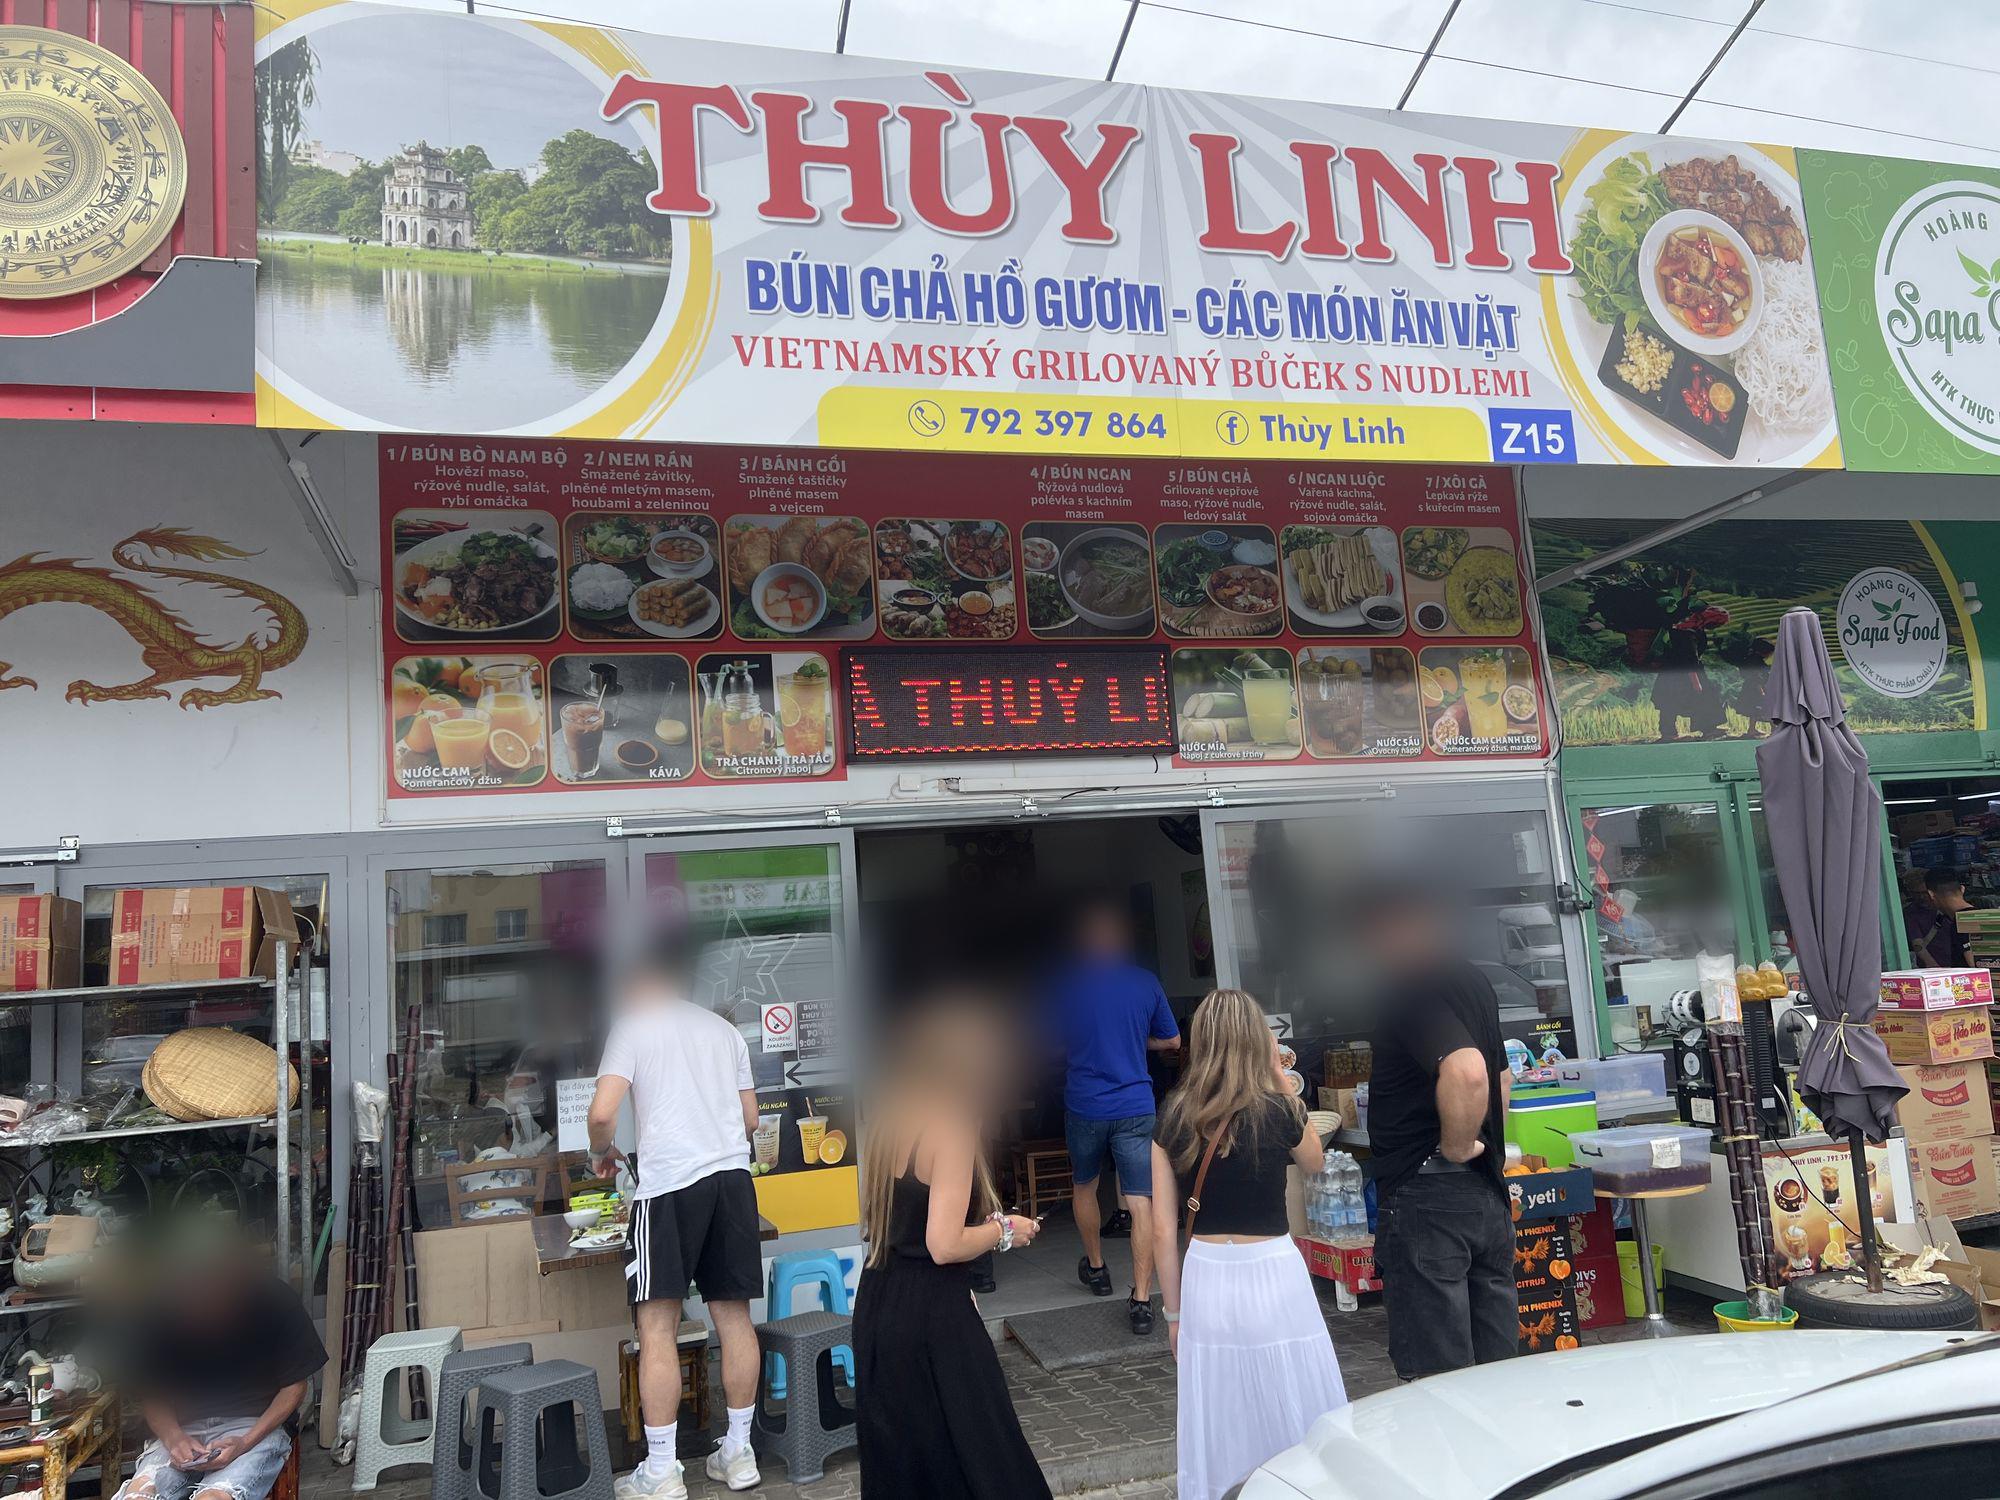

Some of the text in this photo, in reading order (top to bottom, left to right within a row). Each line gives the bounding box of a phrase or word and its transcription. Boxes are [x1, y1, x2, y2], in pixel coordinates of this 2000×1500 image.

[602, 70, 1574, 272] THÙY LINH
[1923, 209, 1988, 242] HOÀNG
[745, 252, 1520, 359] BÚN CHẢ HỒ GƯƠM - CÁC MÓN ĂN VẶT
[1886, 280, 1985, 356] Sapa
[732, 335, 1532, 398] VIETNAMSKÝ GRILOVANÝ BŮČEK S NUDLEMI
[1930, 369, 1995, 425] HTK THỰC
[960, 407, 1167, 440] 792 397 864
[1259, 414, 1405, 450] Thùy Linh
[1500, 423, 1565, 455] Z15
[387, 448, 395, 461] 1
[411, 443, 454, 461] BÚN
[460, 444, 486, 463] BÒ
[491, 449, 536, 464] NAM
[541, 447, 567, 468] BỘ
[584, 453, 594, 465] 2
[608, 452, 650, 467] NEM
[654, 450, 693, 468] RÁN
[739, 457, 749, 470] 3
[761, 454, 812, 472] BÁNH
[816, 454, 847, 473] GỐI
[435, 464, 529, 479] Hovězí maso,
[581, 468, 695, 484] Smažené závitky,
[1030, 463, 1132, 481] 4 BÚN NGAN
[1168, 467, 1252, 483] 5 BÚN CHẢ
[414, 479, 550, 494] rýžové nudle, salát,
[738, 472, 847, 489] Smažené taštičky
[1288, 470, 1386, 489] 6 NGAN LUỘC
[1425, 473, 1487, 489] 7 XÔI GÀ
[561, 482, 715, 498] plněné mletým masem,
[749, 487, 840, 500] plněné masem
[1037, 481, 1124, 494] Rýžová nudlová
[1163, 484, 1259, 498] Grilované vepřové
[1298, 487, 1376, 499] Vařená kachna,
[442, 494, 528, 507] rybí omáčka
[572, 496, 710, 511] houbami a zeleninou
[1031, 494, 1133, 507] polévka s kachním
[1160, 497, 1265, 510] maso, rýžové nudle,
[1425, 490, 1489, 502] Lepkavá rýže
[769, 502, 825, 515] a vejcem
[1289, 499, 1387, 512] rýžové nudle, salát,
[1418, 502, 1501, 513] s kuřecím masem
[1065, 509, 1105, 519] masem
[1183, 509, 1247, 522] ledový salát
[1303, 511, 1378, 524] sojová omáčka
[1854, 578, 1916, 602] HOÀNG GIA
[1842, 613, 1941, 648] Sapa Food
[1859, 660, 1874, 677] HTK
[1179, 741, 1226, 752] NƯỚC MÍA
[1376, 737, 1402, 747] NƯỚC
[1445, 735, 1470, 746] NƯỚC
[1470, 736, 1489, 745] CAM
[1521, 735, 1537, 744] LEO
[715, 754, 740, 767] TRÀ
[785, 753, 807, 765] TRÀ
[402, 765, 470, 778] NƯỚC CAM
[649, 765, 682, 778] KÁVA
[736, 764, 812, 776] Citronový nápoj
[402, 775, 502, 788] Pomerančový džus
[1527, 1188, 1556, 1209] yeti
[1516, 1277, 1546, 1289] CITRUS
[1530, 1299, 1563, 1312] PHŒNIX
